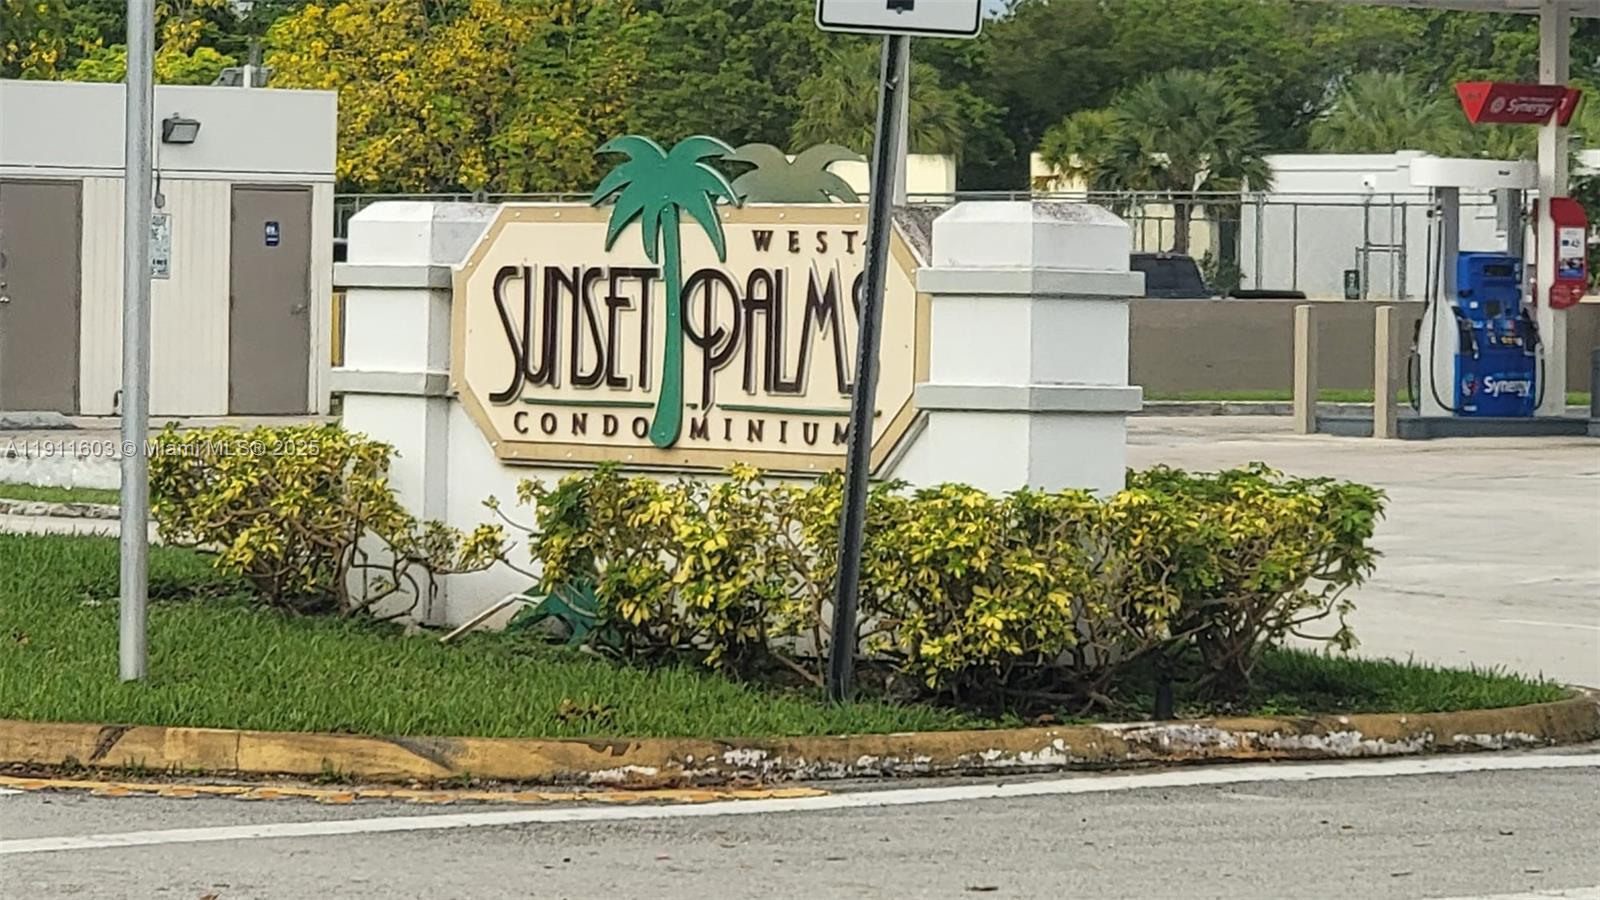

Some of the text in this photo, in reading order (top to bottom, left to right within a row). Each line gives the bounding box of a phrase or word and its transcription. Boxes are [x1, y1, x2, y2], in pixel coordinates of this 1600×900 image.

[751, 230, 859, 254] WEST
[489, 265, 867, 411] SUNSET PALM
